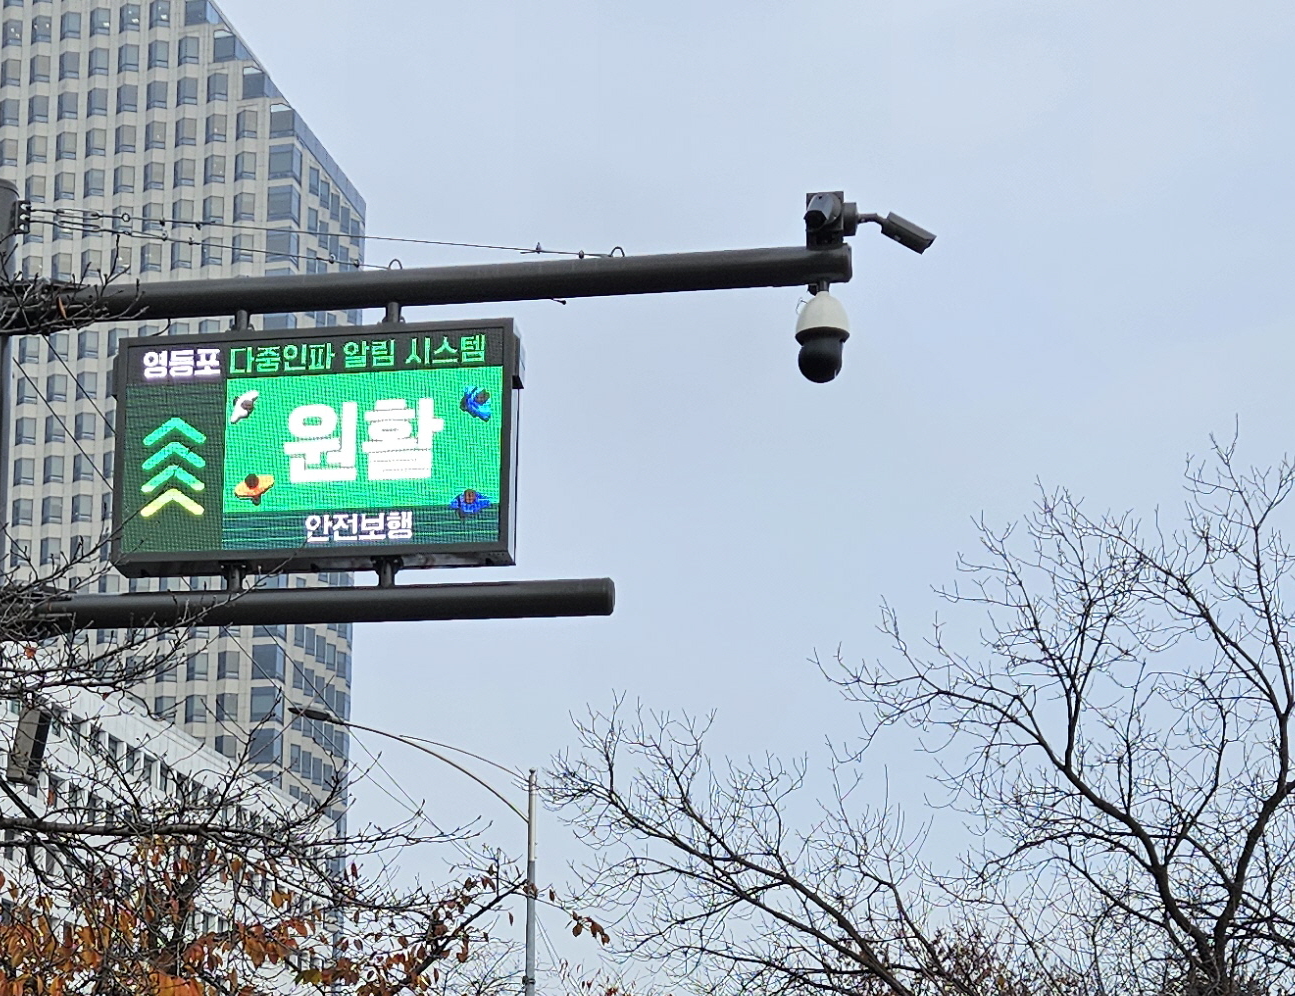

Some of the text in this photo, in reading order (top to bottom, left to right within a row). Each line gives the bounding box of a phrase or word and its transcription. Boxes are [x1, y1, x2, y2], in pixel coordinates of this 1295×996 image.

[142, 334, 486, 379] 영등포 다중인파 알림 시스템
[283, 397, 445, 484] 원활
[305, 511, 414, 543] 안전보행
